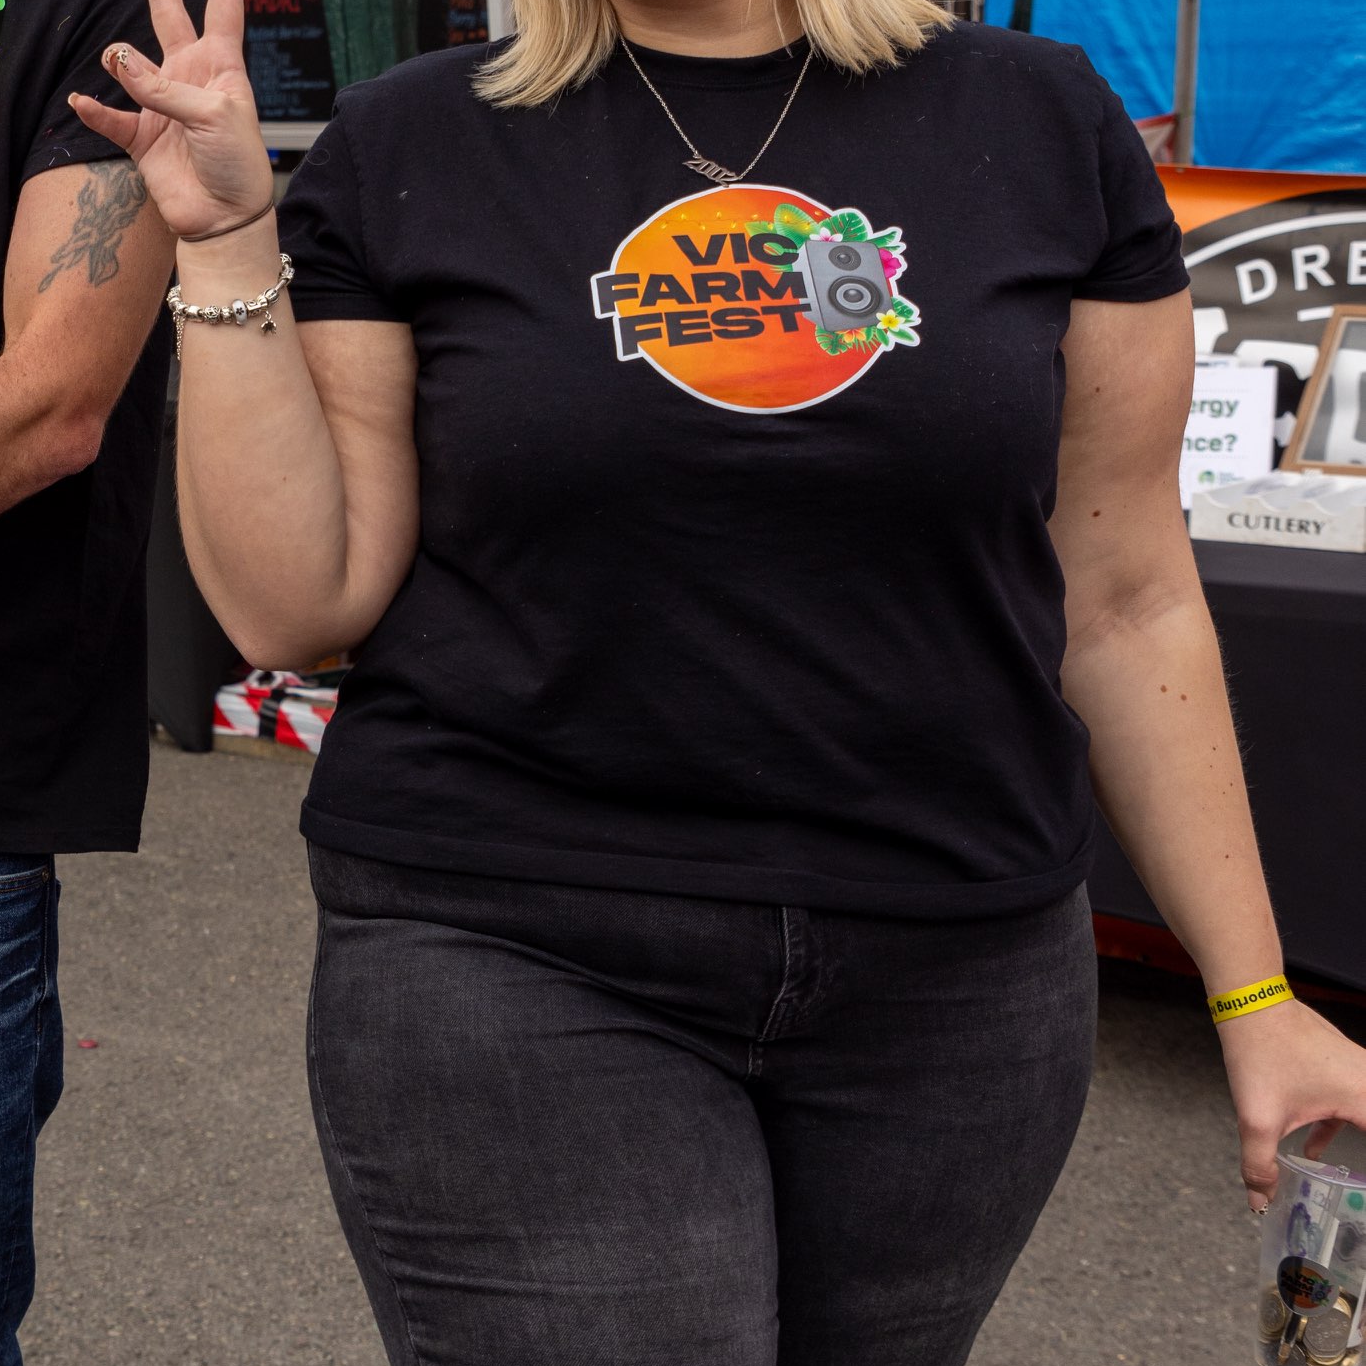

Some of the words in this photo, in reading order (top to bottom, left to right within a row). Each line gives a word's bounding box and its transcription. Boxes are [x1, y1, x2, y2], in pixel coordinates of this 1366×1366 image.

[671, 232, 800, 267] VIC
[595, 269, 809, 315] FARM
[618, 302, 812, 357] FEST
[1227, 512, 1326, 535] CUTLERY
[1216, 982, 1286, 1013] supporting
